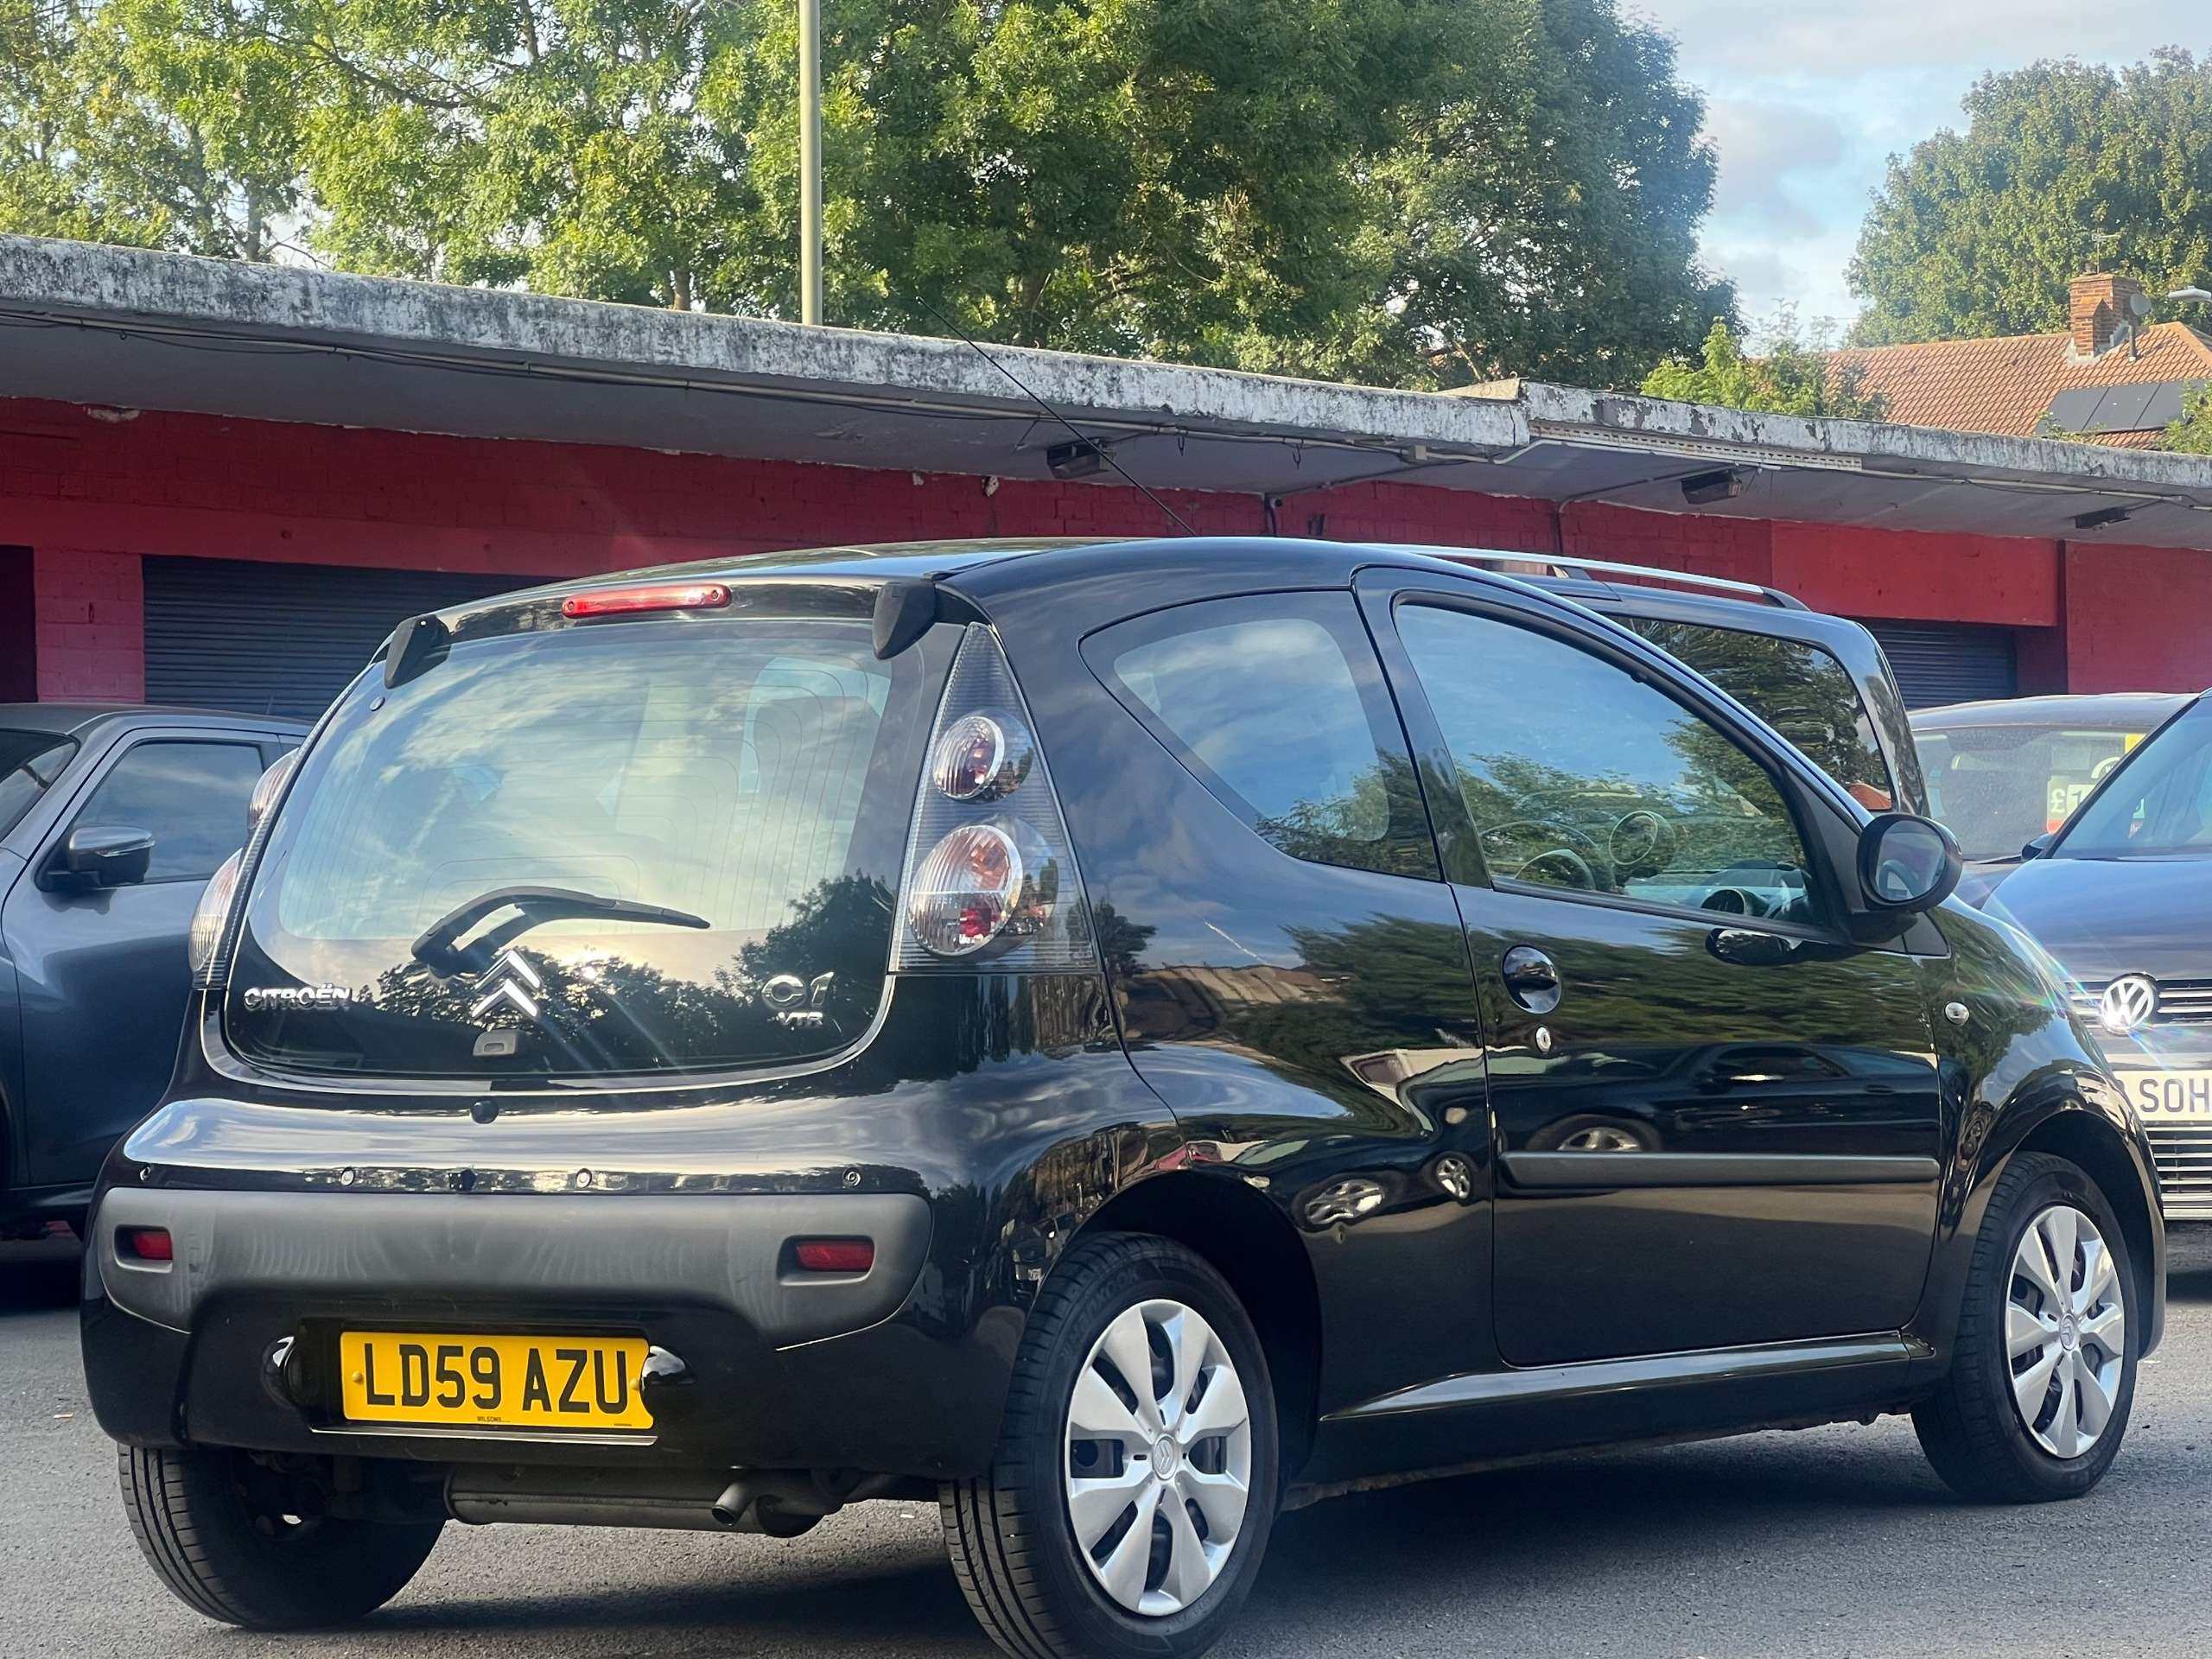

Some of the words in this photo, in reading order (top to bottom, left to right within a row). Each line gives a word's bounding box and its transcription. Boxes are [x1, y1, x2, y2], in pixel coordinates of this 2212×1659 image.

[244, 982, 352, 1011] CITROËN
[761, 972, 835, 1009] C1
[778, 1011, 823, 1027] VTR
[2139, 1078, 2210, 1113] SOH
[364, 1343, 502, 1410] LD59
[522, 1348, 628, 1414] AZU
